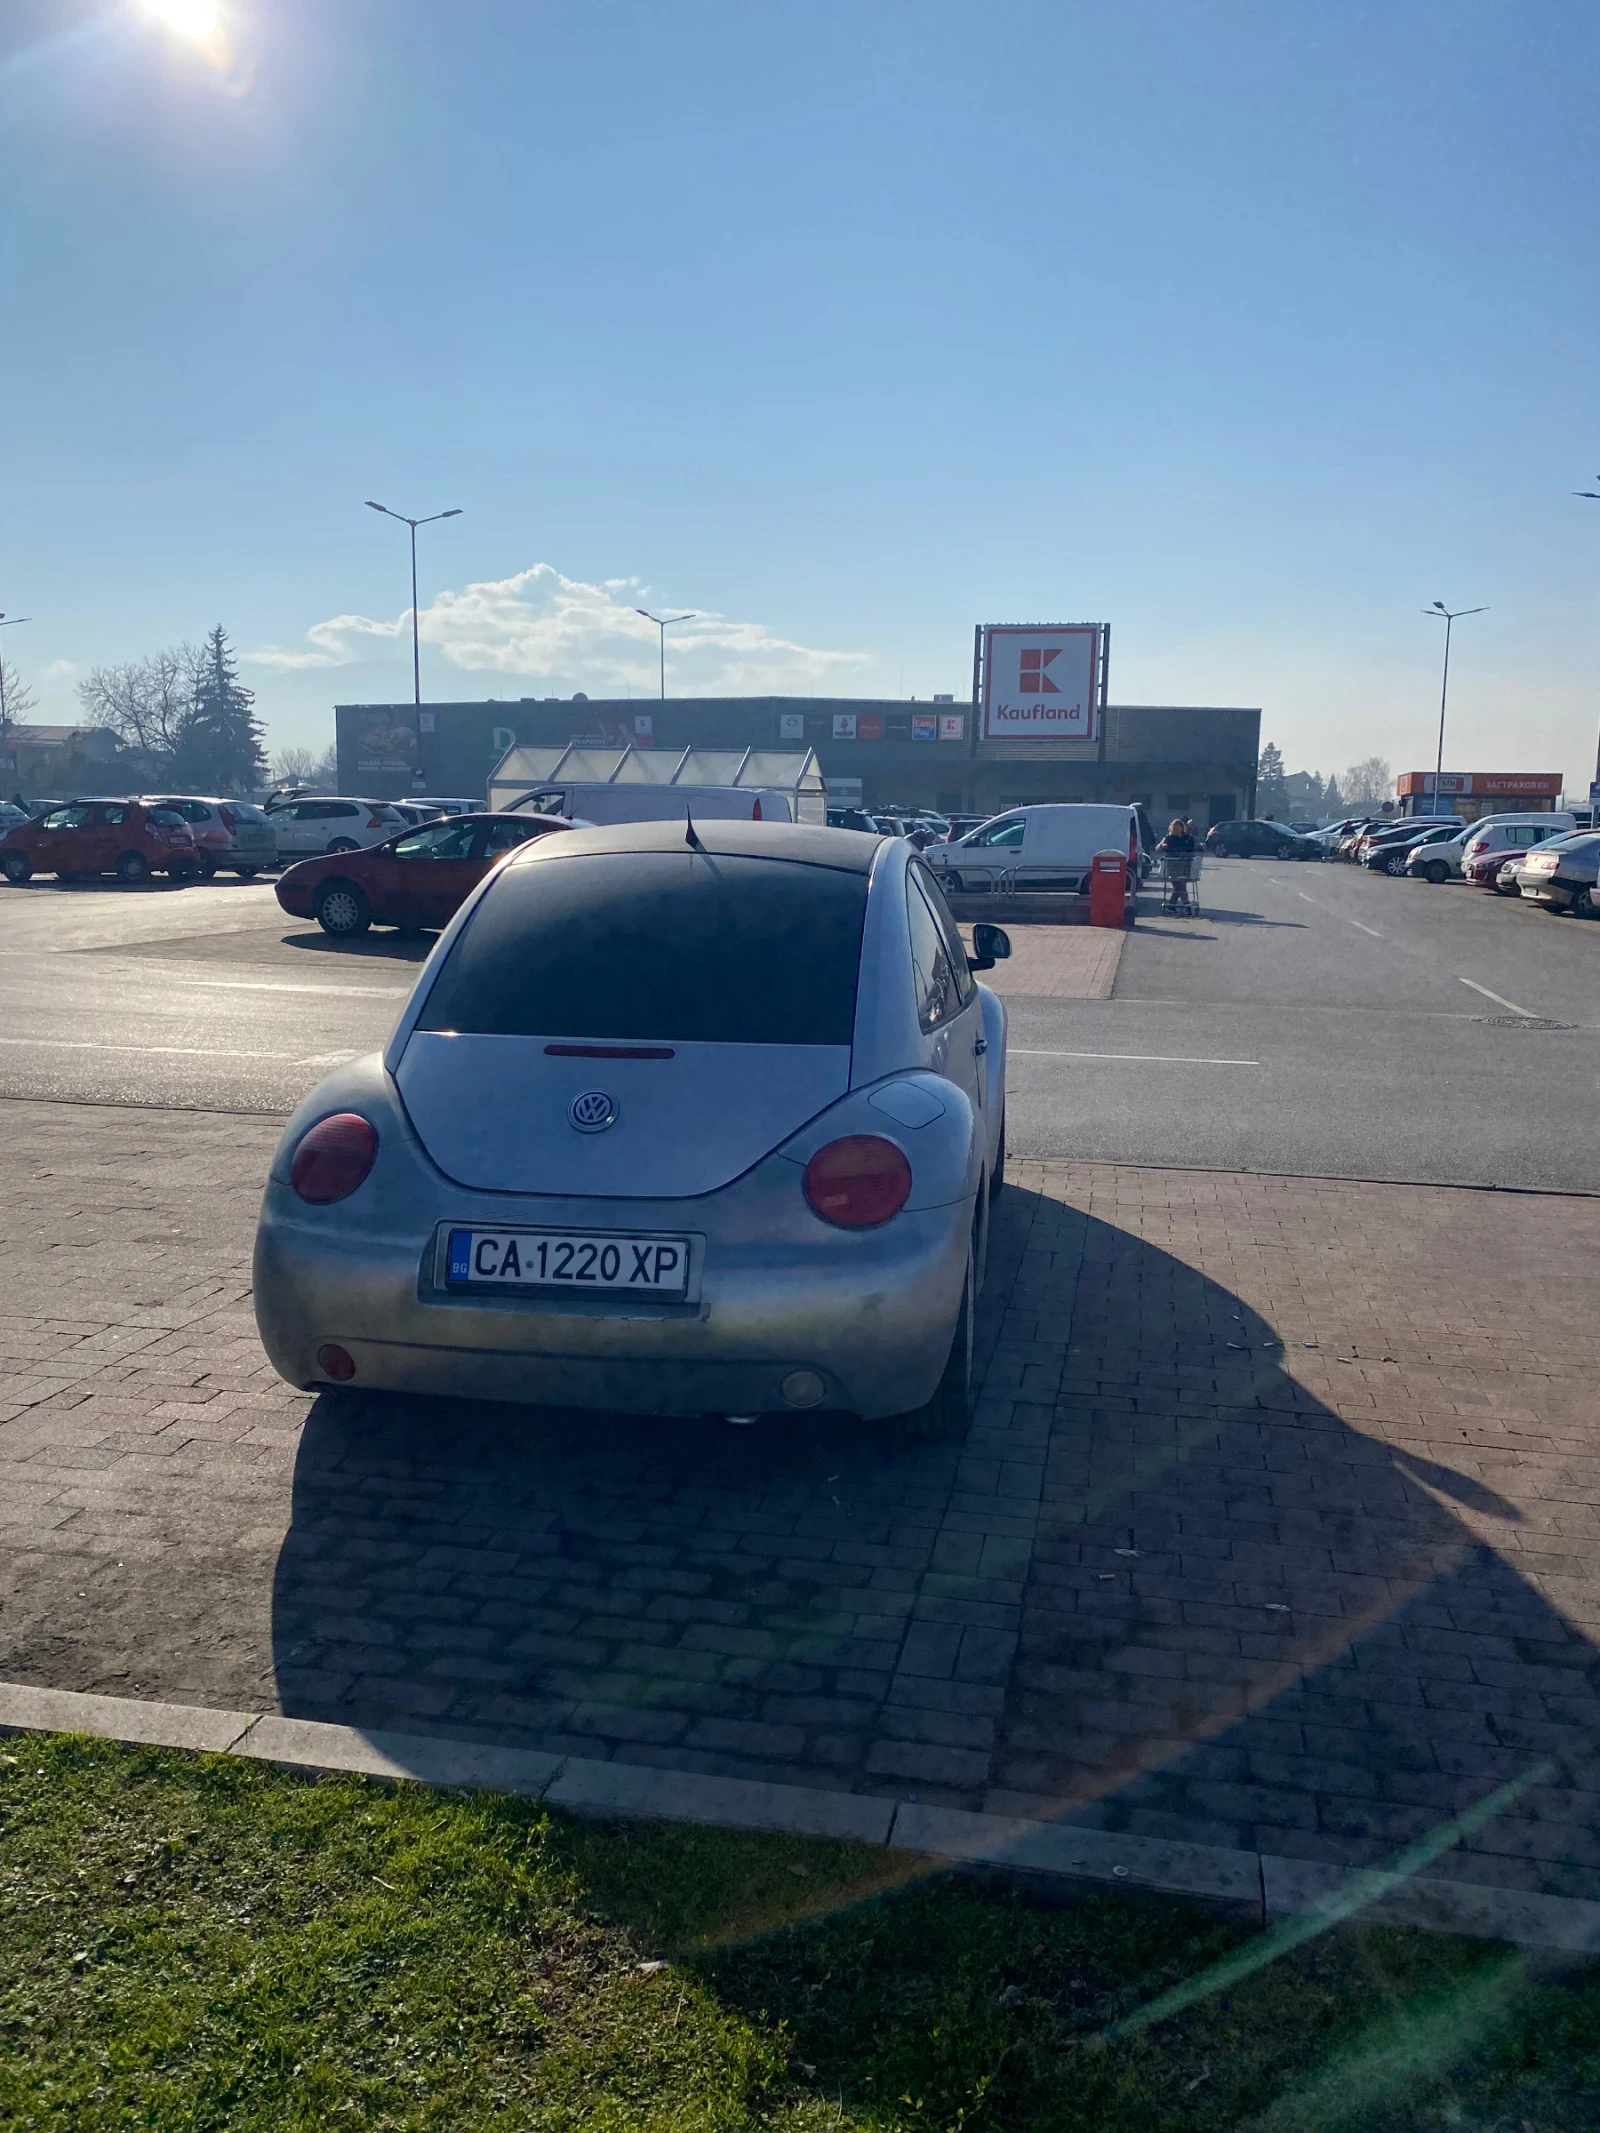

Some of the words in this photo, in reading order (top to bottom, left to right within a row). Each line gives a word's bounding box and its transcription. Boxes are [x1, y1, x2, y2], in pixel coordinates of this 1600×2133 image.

[997, 704, 1081, 720] Kaufland
[914, 719, 935, 729] Easy
[914, 728, 930, 737] Pay
[1485, 781, 1549, 789] ЗАСТРАХОВКИ
[536, 1241, 622, 1282] 1220
[452, 1262, 468, 1274] BG
